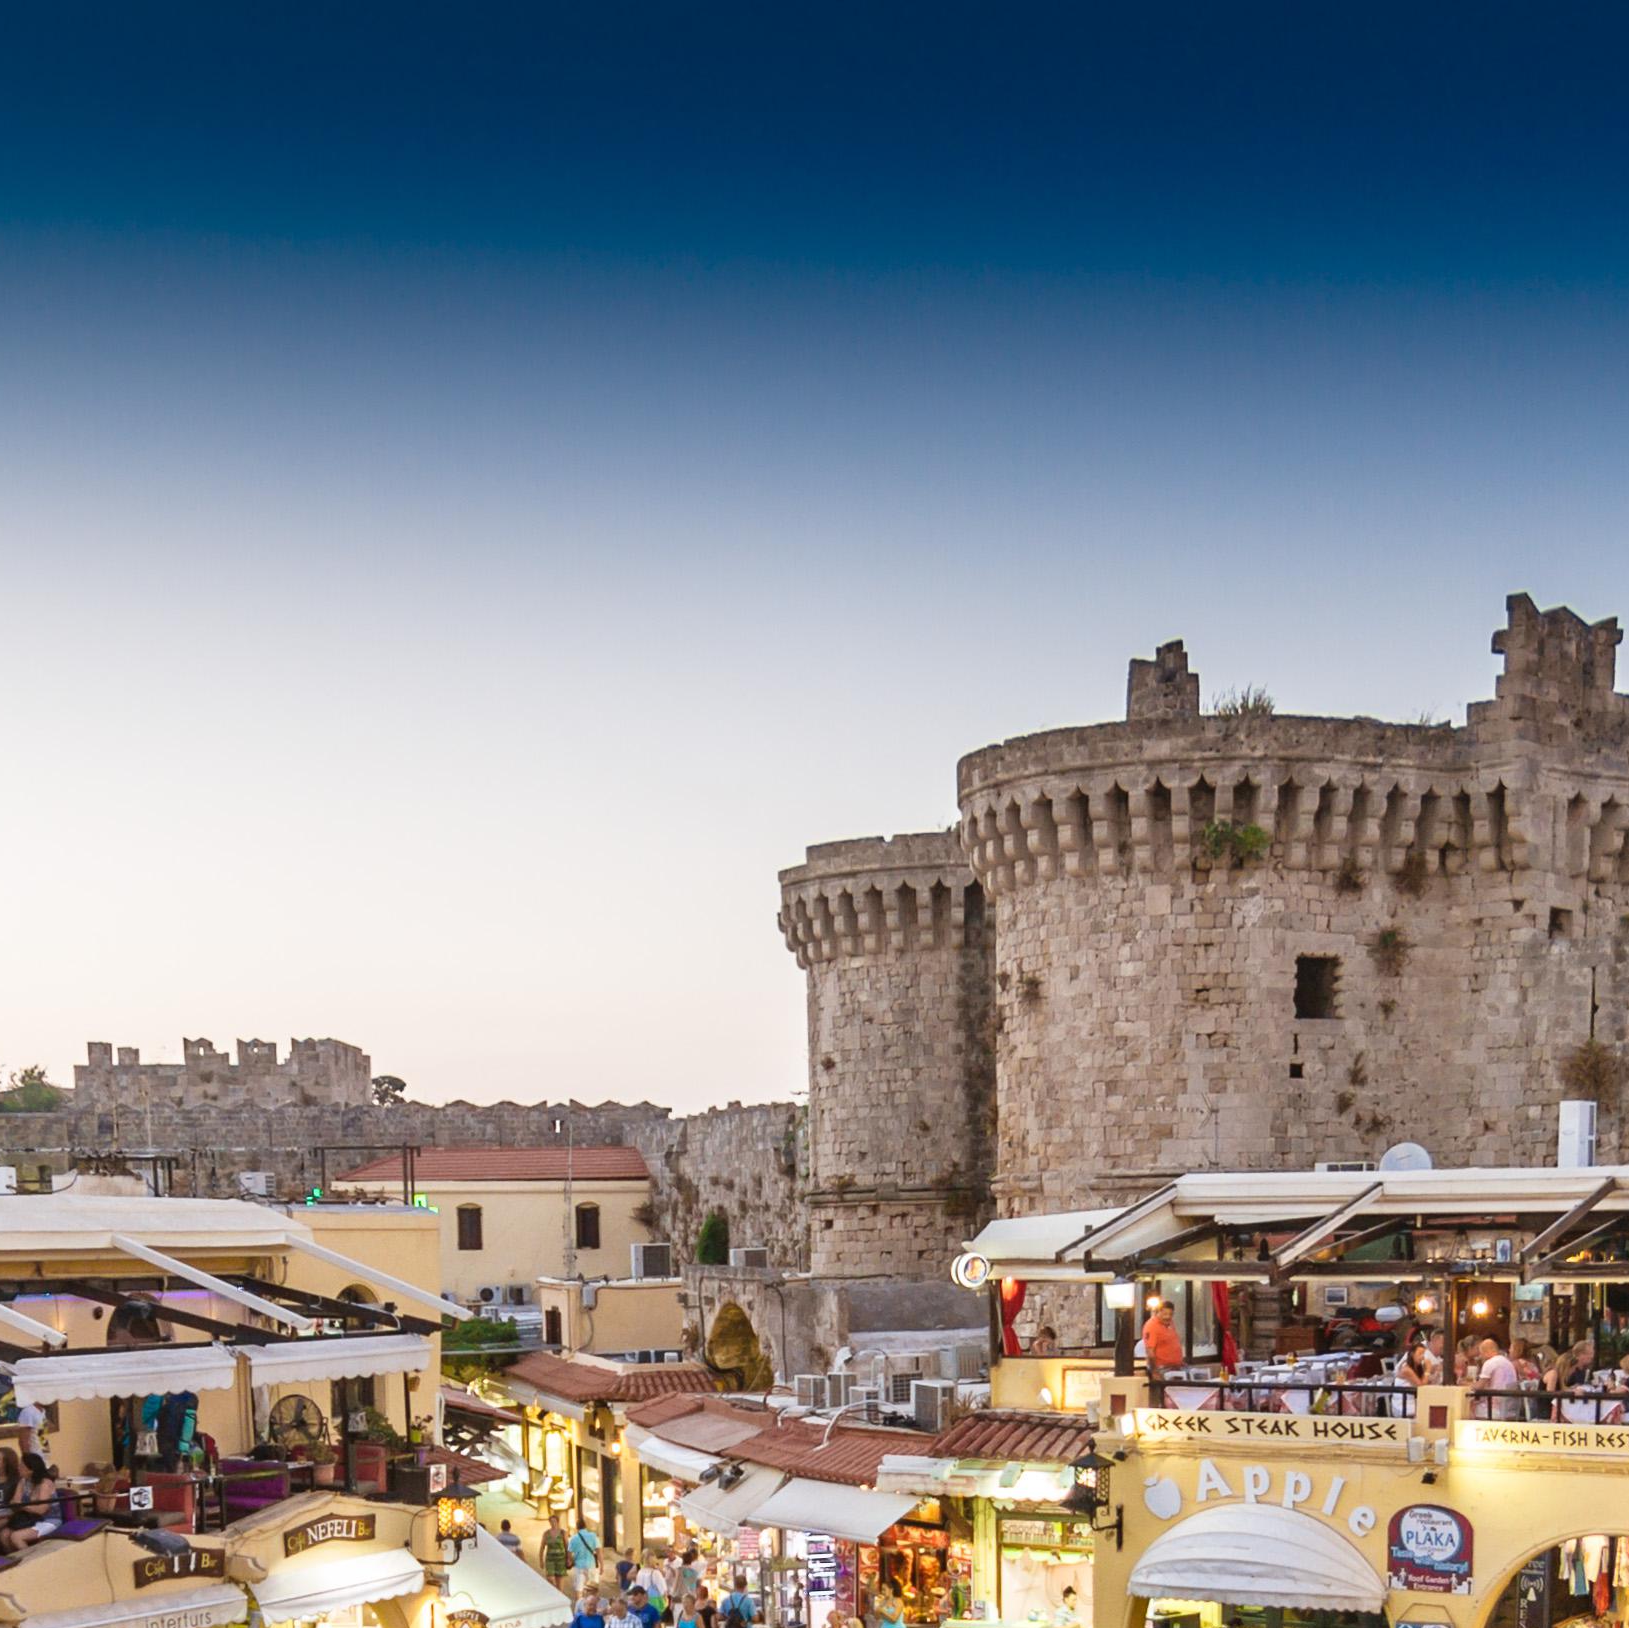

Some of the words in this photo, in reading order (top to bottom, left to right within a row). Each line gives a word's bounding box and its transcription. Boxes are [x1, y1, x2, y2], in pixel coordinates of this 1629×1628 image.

[1145, 1414, 1212, 1433] GREEK
[1225, 1417, 1300, 1437] STEAK
[1313, 1421, 1397, 1440] HOUSE
[1475, 1426, 1588, 1447] TAVERNA-FISH
[1195, 1459, 1377, 1538] Apple
[306, 1518, 357, 1545] NEFELI
[1406, 1530, 1456, 1547] PLAKA
